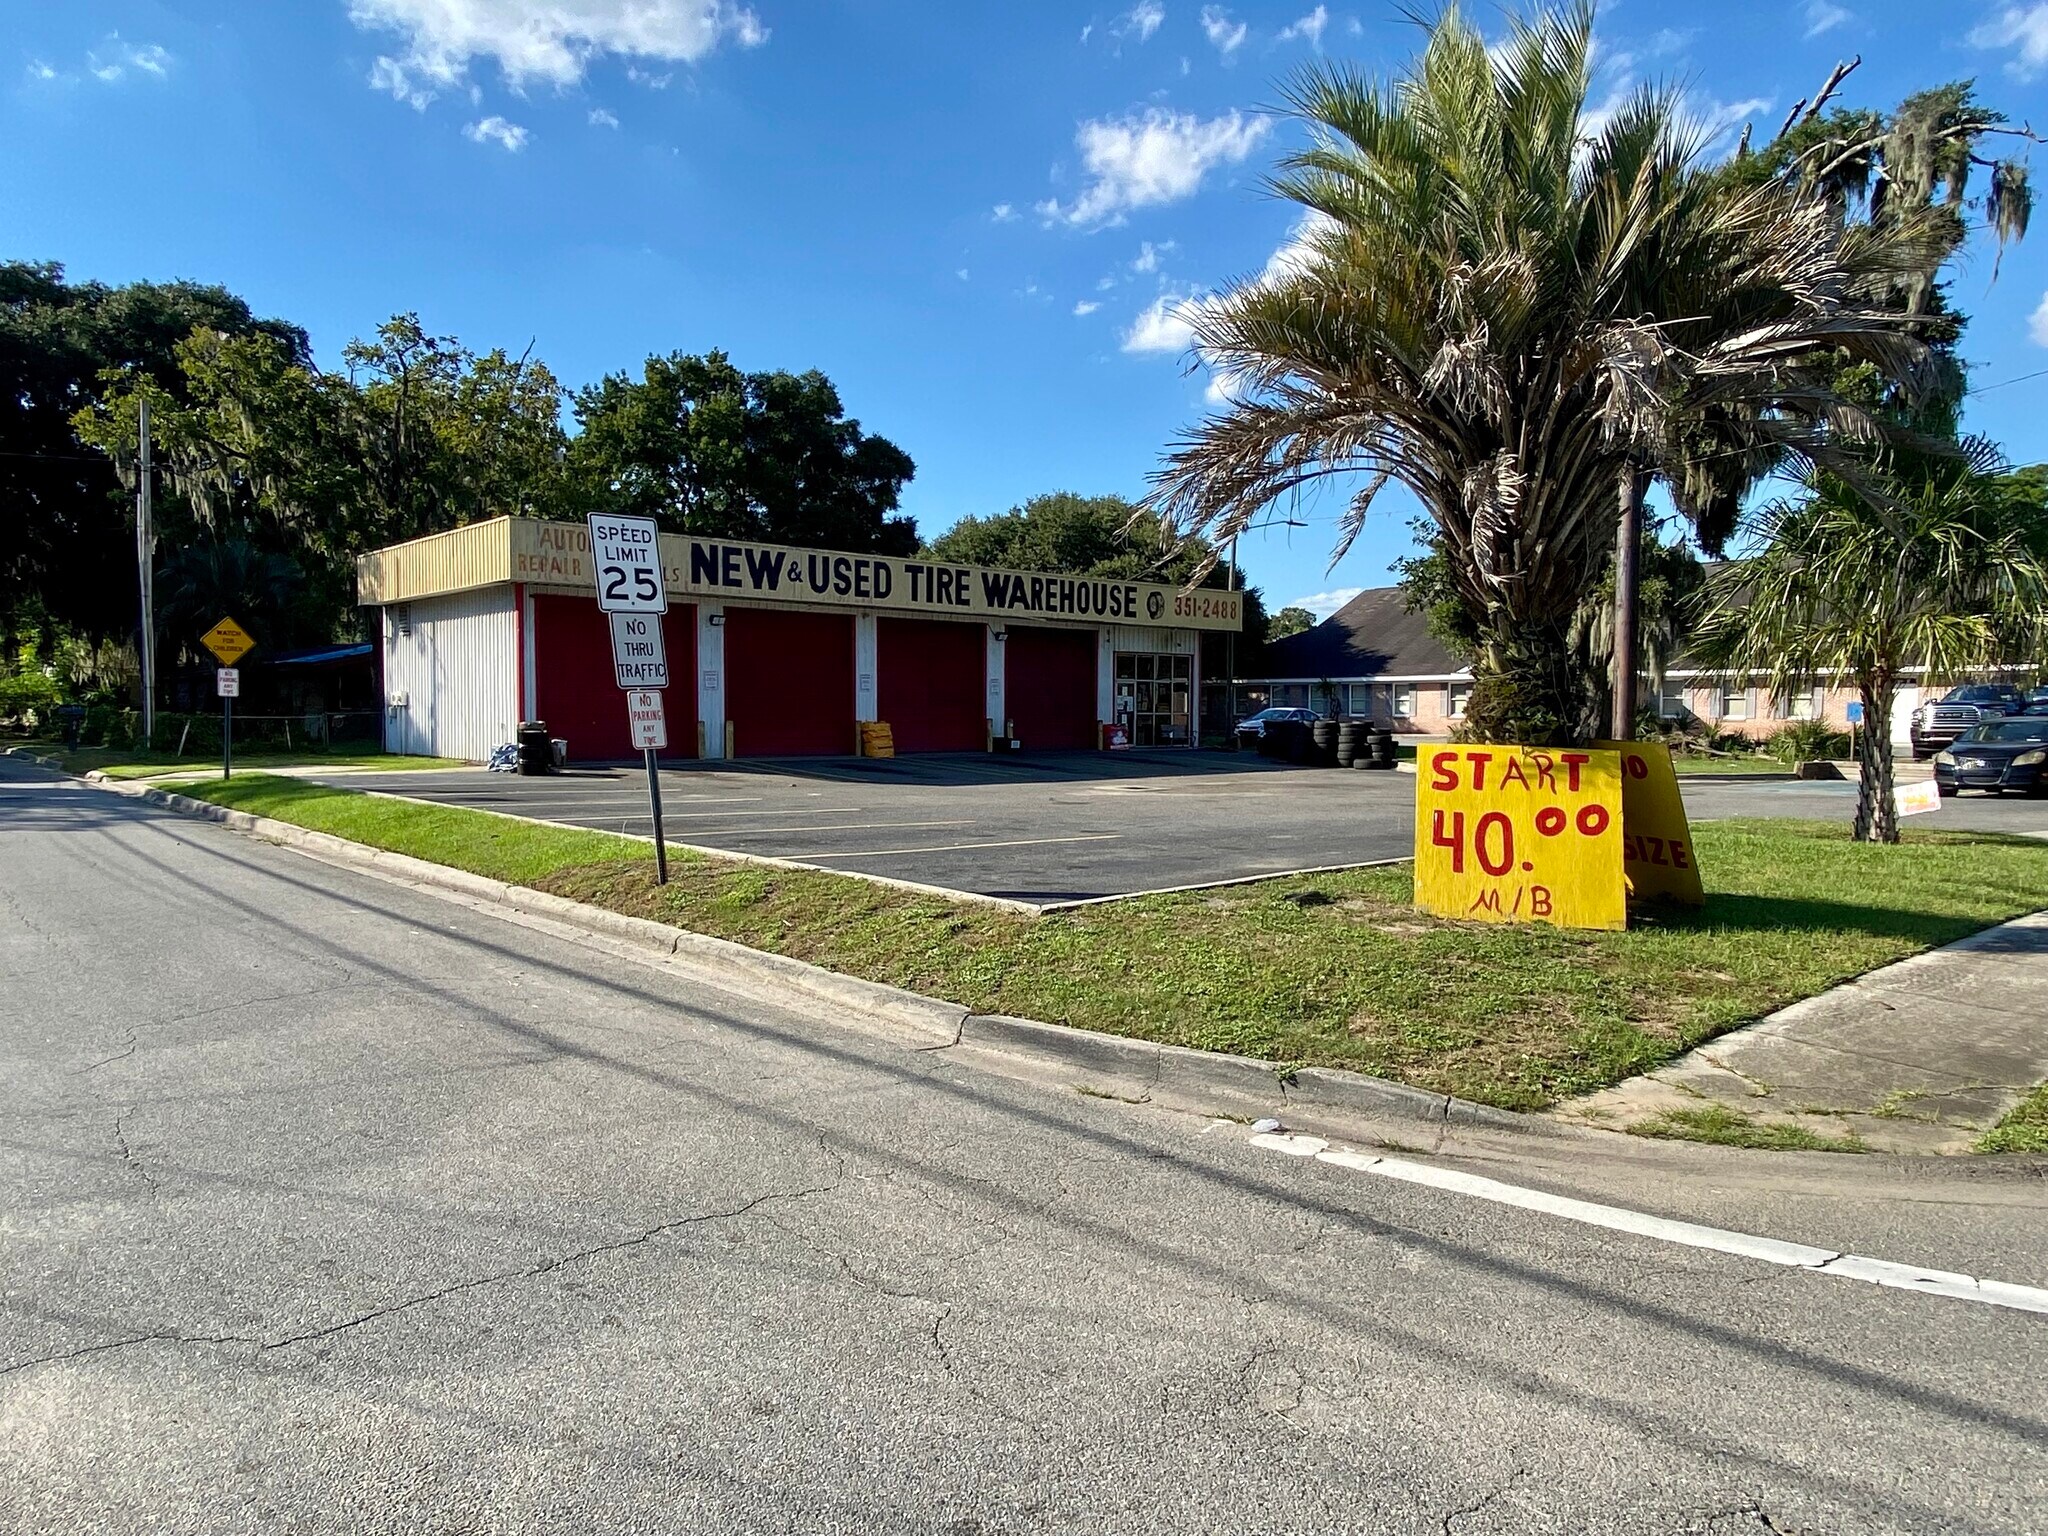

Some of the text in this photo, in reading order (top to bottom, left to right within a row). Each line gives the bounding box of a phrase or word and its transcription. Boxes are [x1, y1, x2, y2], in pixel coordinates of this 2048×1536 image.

[597, 525, 652, 544] SPEED
[604, 545, 648, 563] LIMIT
[602, 566, 658, 601] 25
[690, 542, 1138, 618] NEW & USED TIRE WAREHOUSE
[1174, 596, 1237, 620] 351-2488
[626, 620, 646, 635] NO
[624, 642, 654, 657] THRU
[618, 663, 666, 678] TRAFFIC
[639, 695, 652, 707] NO
[633, 710, 662, 721] PARKING
[643, 724, 655, 733] ANY
[1432, 752, 1590, 794] START
[1624, 834, 1689, 869] SIZE
